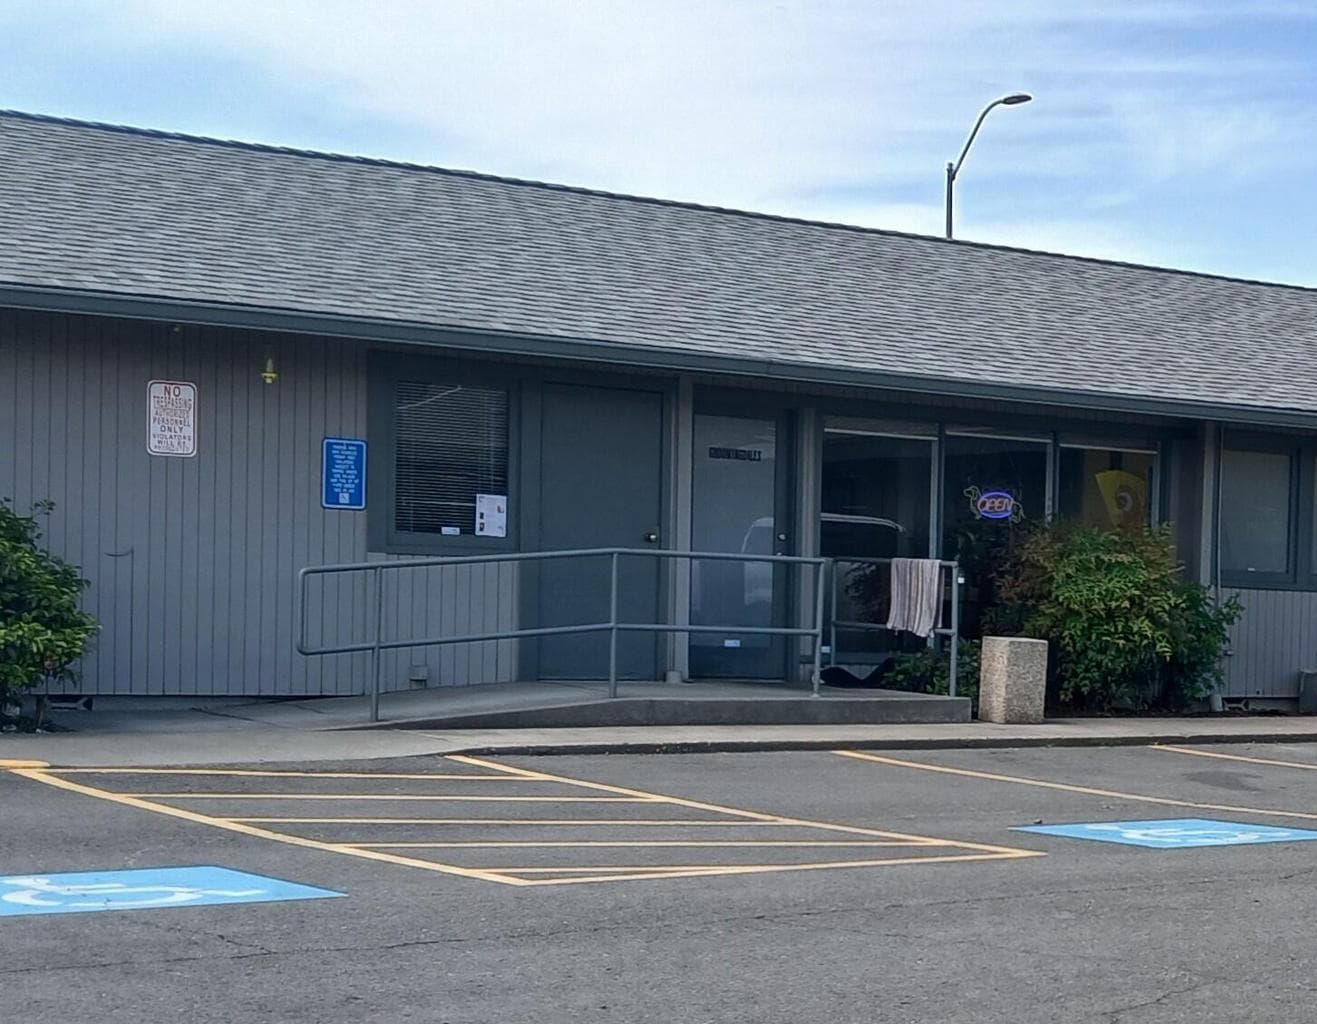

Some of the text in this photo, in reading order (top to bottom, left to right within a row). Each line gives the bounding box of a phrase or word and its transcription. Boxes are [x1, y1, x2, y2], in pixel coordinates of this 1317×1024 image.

[163, 385, 181, 397] NO
[160, 425, 183, 434] ONLY
[979, 498, 1011, 511] OPEN
